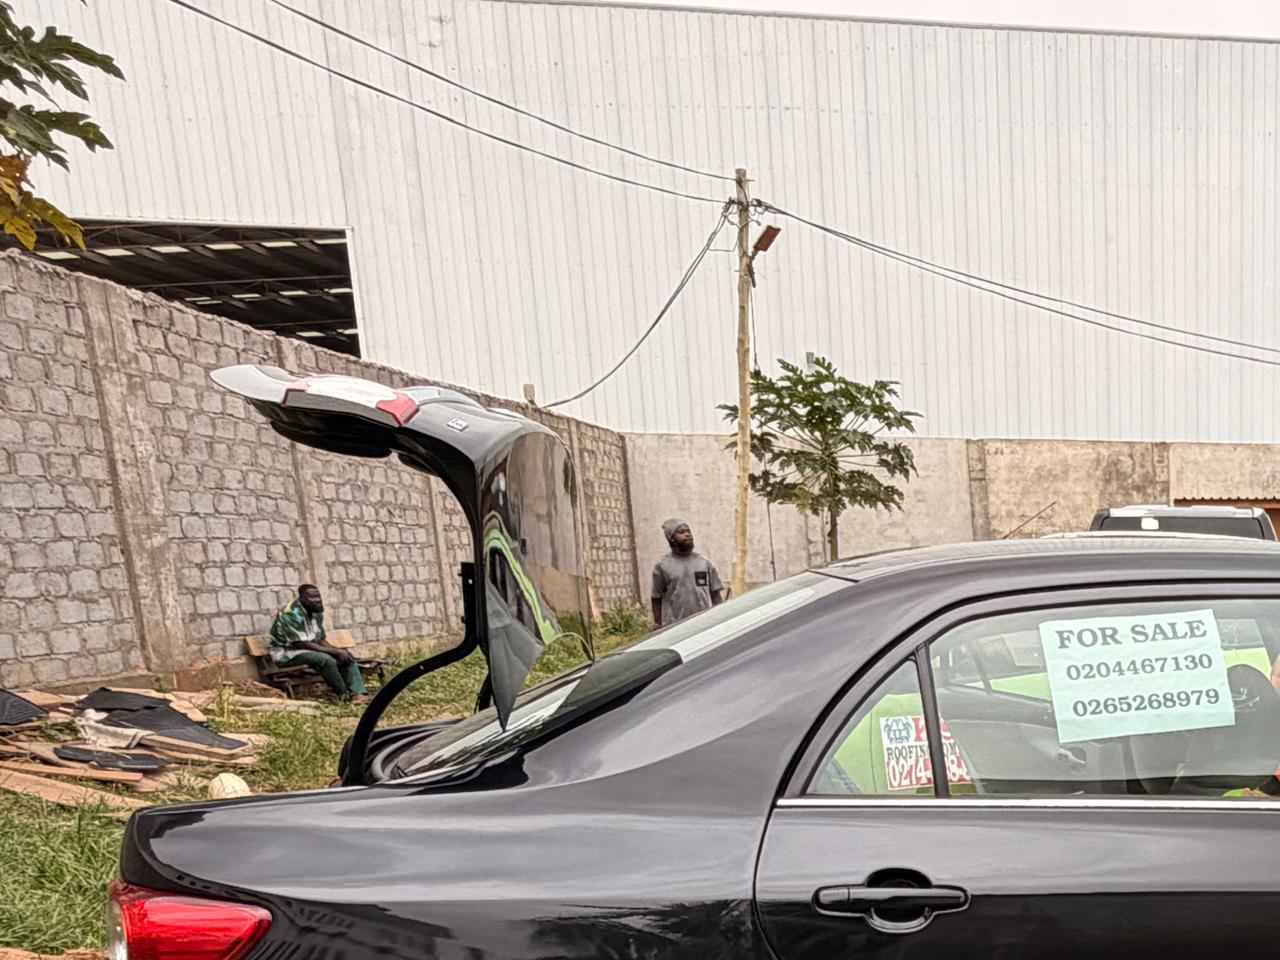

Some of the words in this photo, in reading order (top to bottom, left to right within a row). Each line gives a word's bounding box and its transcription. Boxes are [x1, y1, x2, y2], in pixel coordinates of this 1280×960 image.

[1055, 626, 1123, 650] FOR
[1130, 619, 1207, 644] SALE
[1066, 653, 1213, 681] 0204467130
[1072, 688, 1220, 717] 0265268979
[886, 744, 928, 761] ROOFIN
